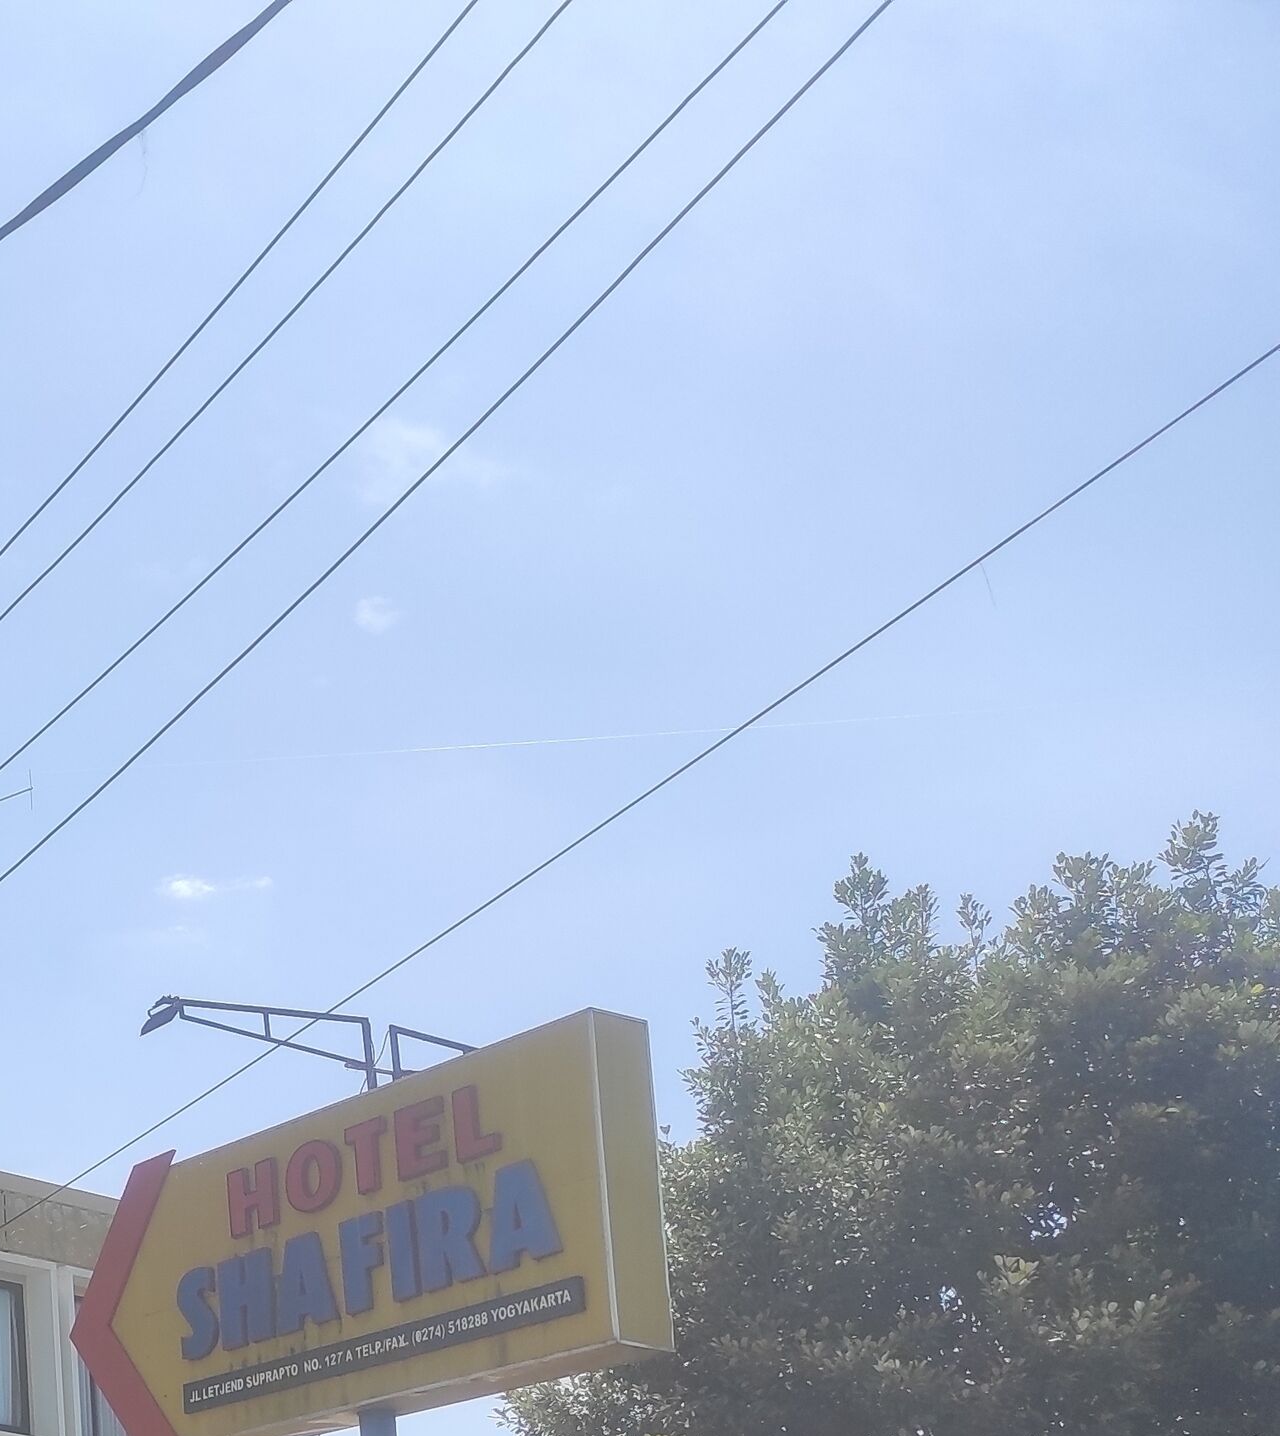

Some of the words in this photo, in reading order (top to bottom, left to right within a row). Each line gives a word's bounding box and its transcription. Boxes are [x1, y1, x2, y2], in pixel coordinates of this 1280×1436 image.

[226, 1085, 502, 1239] HOTEL
[176, 1158, 563, 1361] SHAFIRA
[202, 1378, 244, 1399] LETJEND
[246, 1364, 298, 1388] SUPRAPTO
[304, 1358, 322, 1373] NO.
[324, 1351, 343, 1367] 127
[345, 1349, 353, 1362] A
[411, 1323, 446, 1347] (0274)
[447, 1311, 488, 1335] 518288
[490, 1289, 572, 1322] YOGYAKARTA
